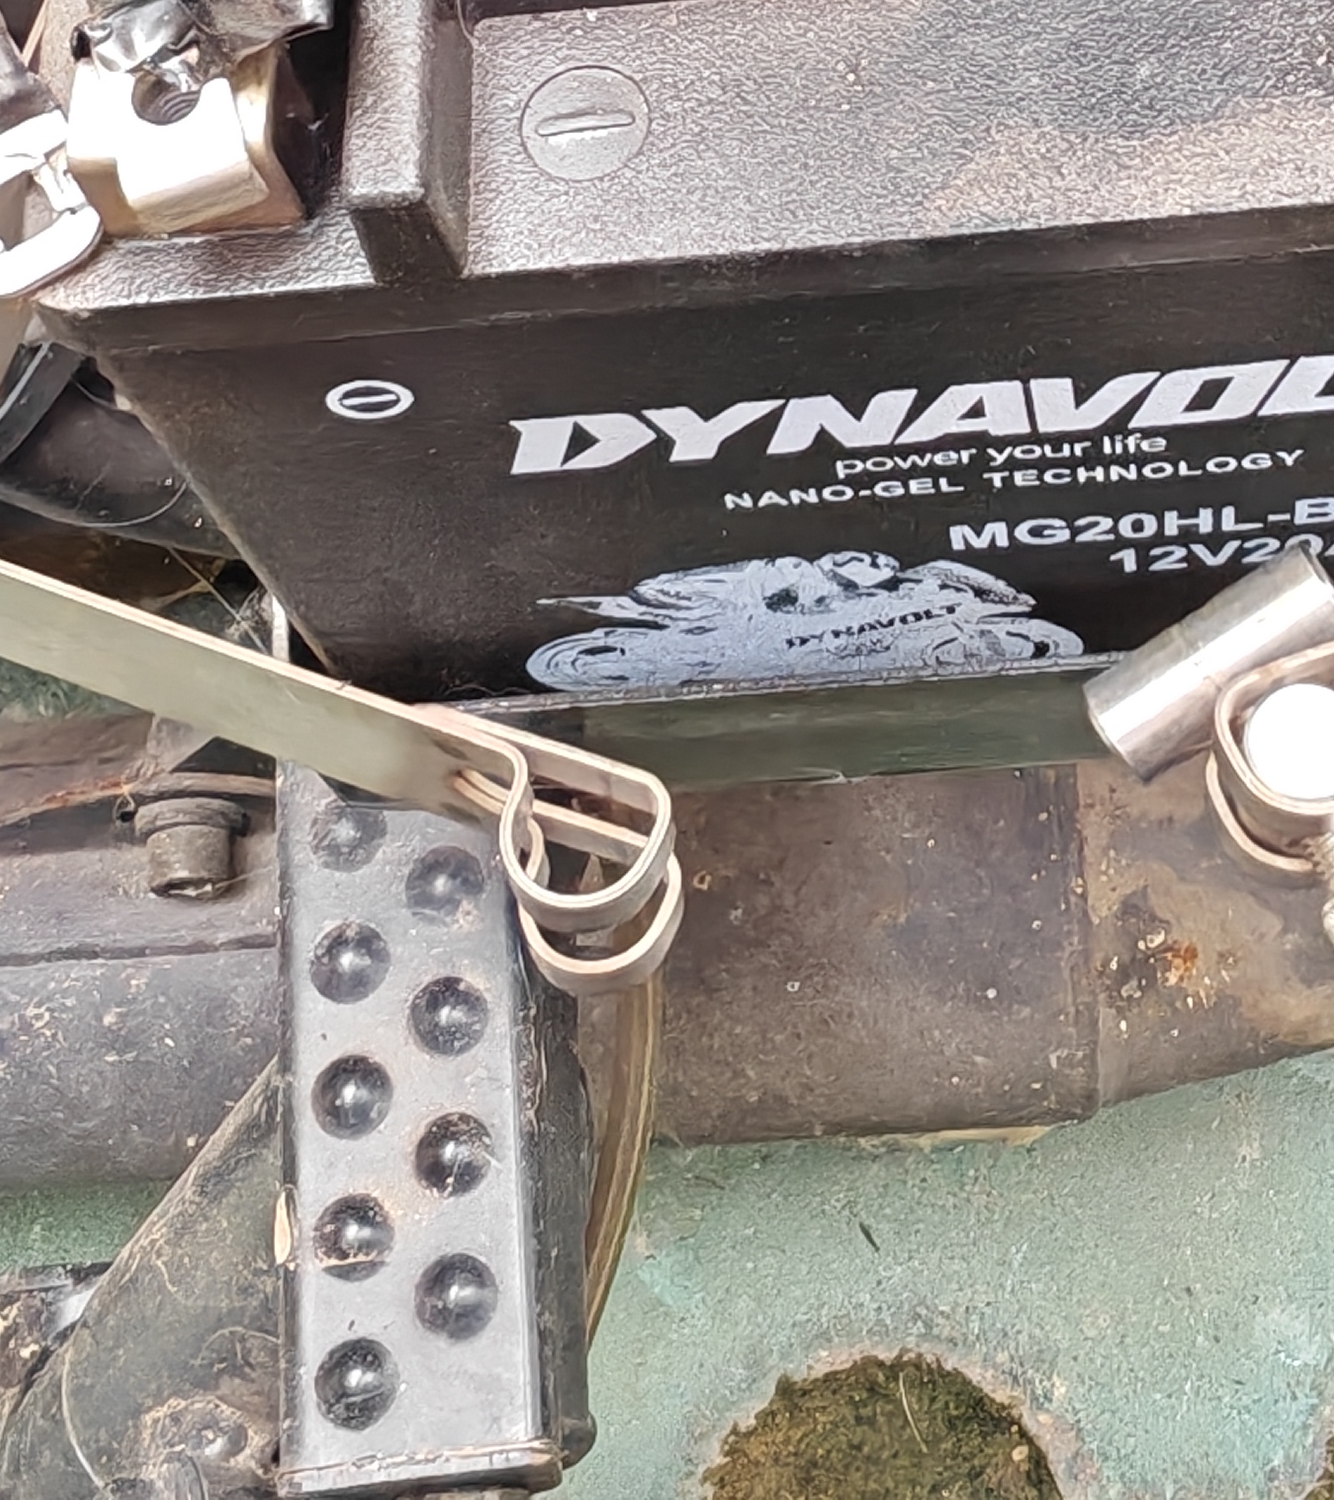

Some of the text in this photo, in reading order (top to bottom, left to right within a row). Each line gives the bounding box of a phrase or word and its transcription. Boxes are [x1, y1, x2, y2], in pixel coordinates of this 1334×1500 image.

[723, 449, 1305, 512] NANO-GEL TECHNOLOGY
[835, 432, 1168, 480] power your life
